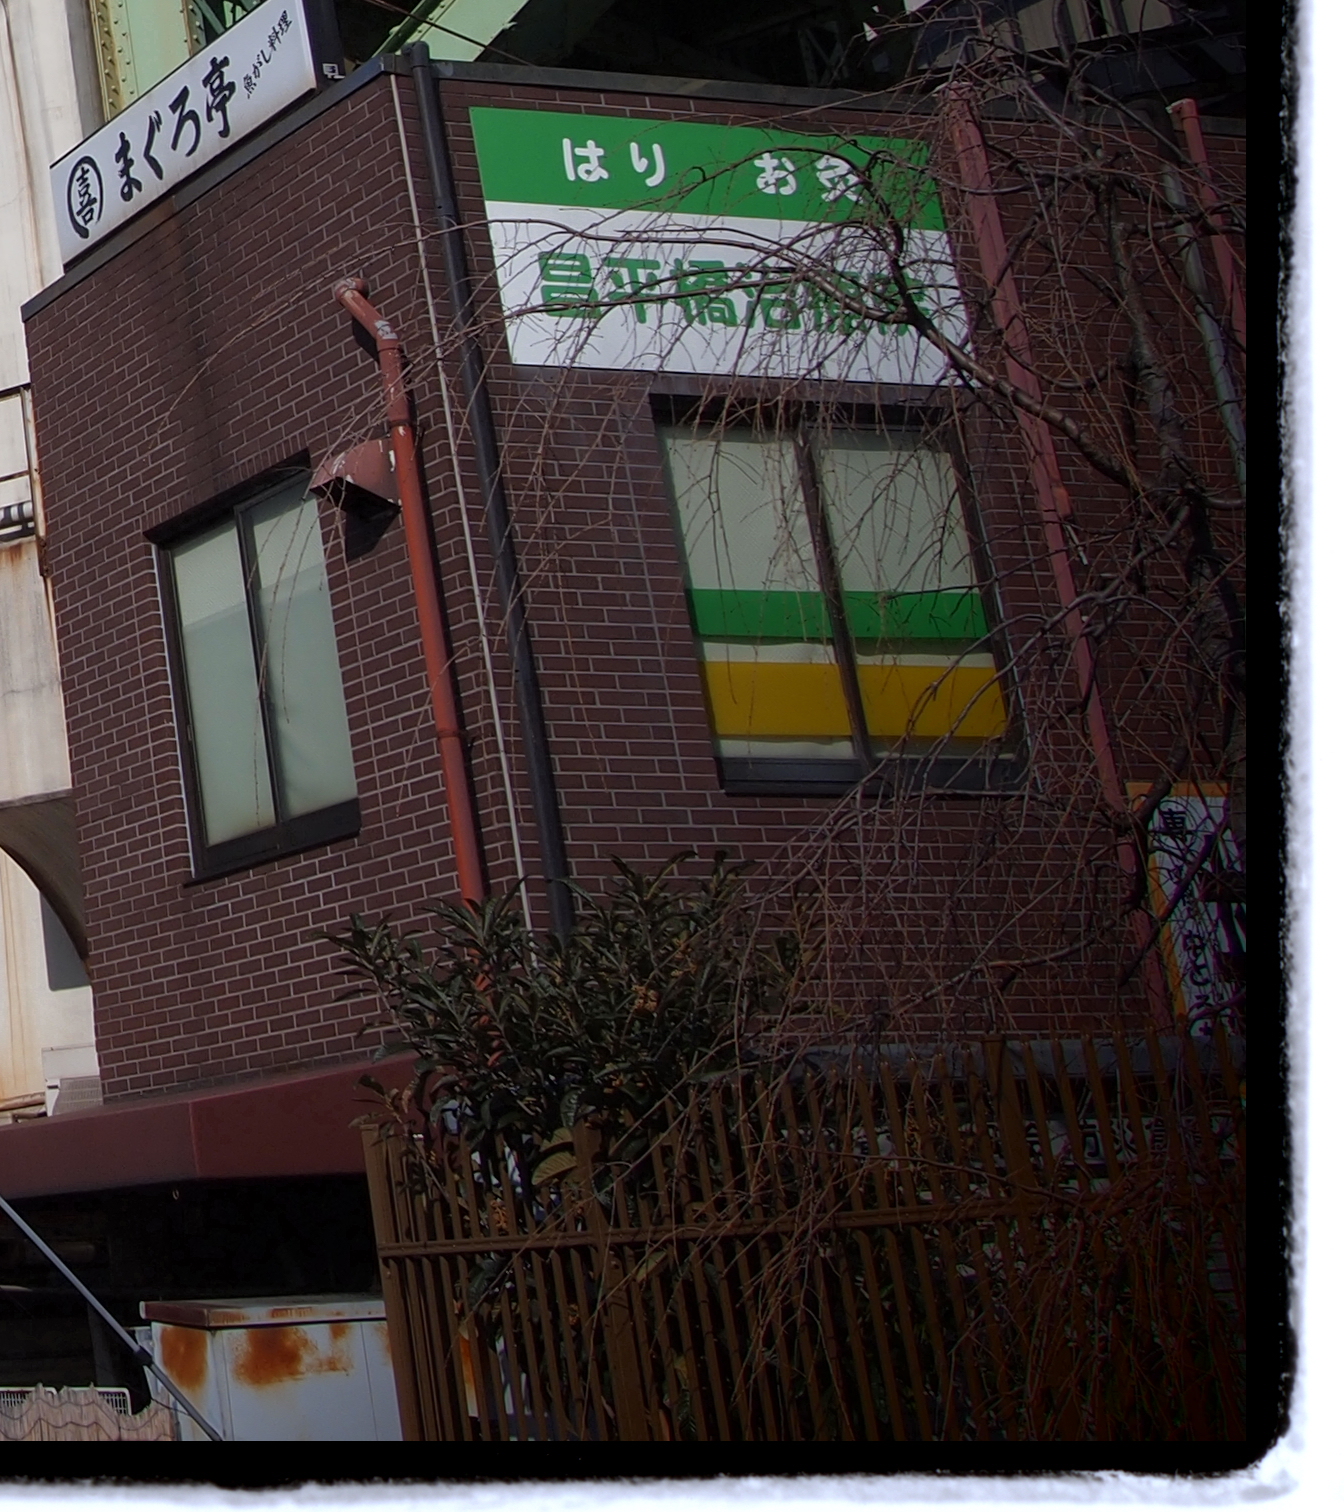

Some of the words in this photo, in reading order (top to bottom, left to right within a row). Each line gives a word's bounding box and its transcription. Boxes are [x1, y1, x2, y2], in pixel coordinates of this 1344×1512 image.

[114, 54, 237, 203] まぐろ亭
[561, 137, 666, 188] はり
